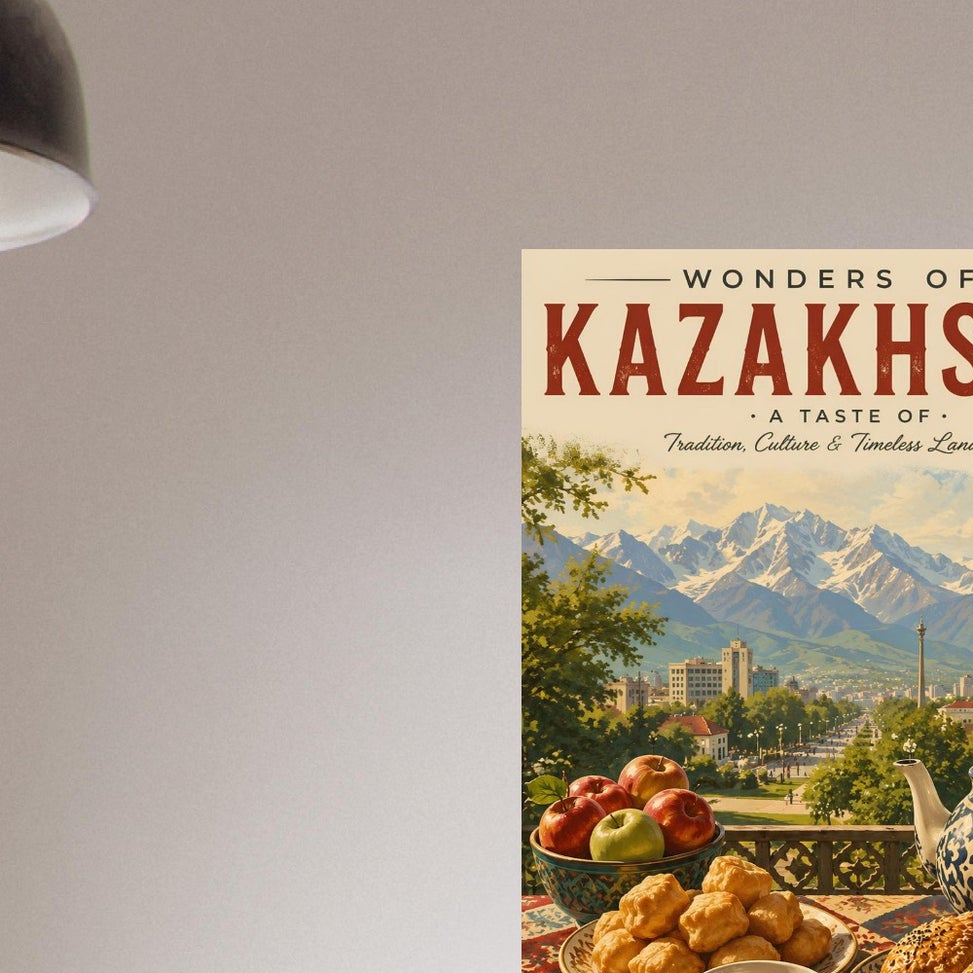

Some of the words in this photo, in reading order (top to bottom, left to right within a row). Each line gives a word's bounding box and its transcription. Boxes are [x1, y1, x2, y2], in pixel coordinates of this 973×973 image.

[682, 268, 893, 290] WONDERS
[768, 408, 784, 424] A
[799, 408, 881, 424] TASTE
[897, 408, 930, 424] OF
[663, 432, 747, 453] Tradition,
[754, 431, 821, 453] Culture
[826, 434, 843, 452] &
[850, 432, 924, 453] Timeless
